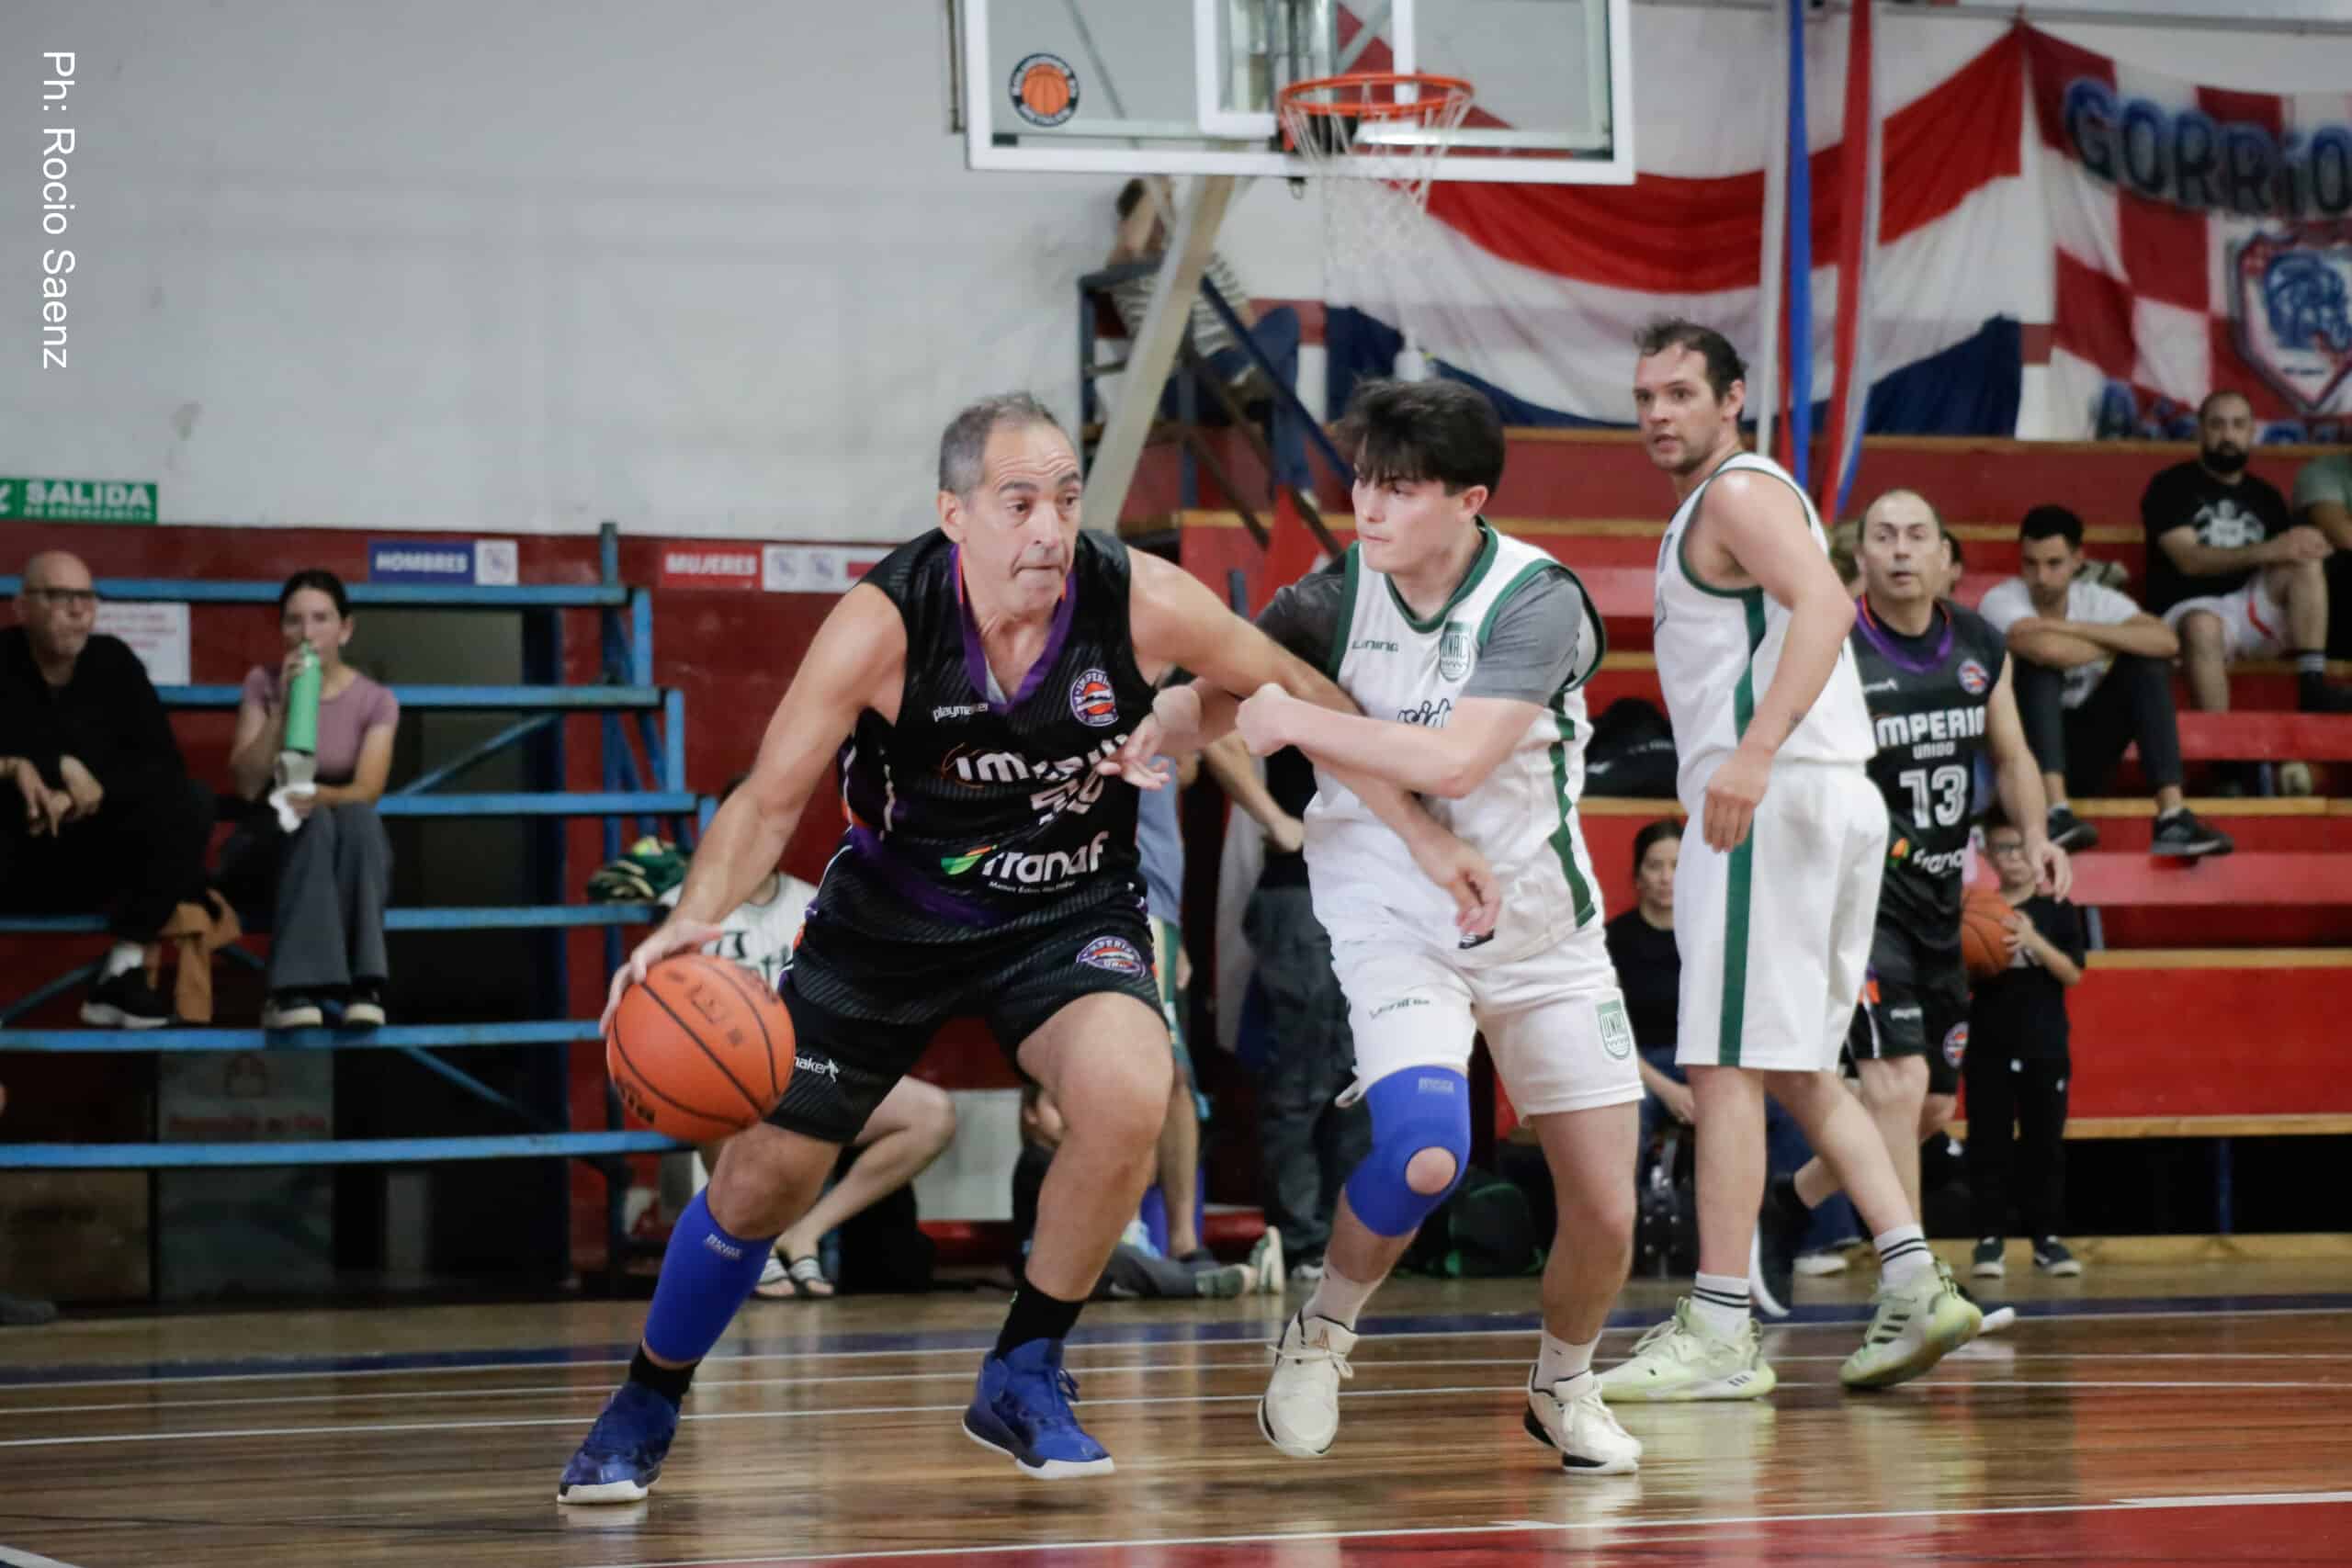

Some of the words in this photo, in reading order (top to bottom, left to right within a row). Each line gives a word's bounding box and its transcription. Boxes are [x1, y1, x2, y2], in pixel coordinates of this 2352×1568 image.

[26, 480, 151, 506] SALIDA
[375, 551, 469, 573] HOMBRES
[665, 553, 758, 575] MUJERES
[1898, 764, 1968, 829] 13
